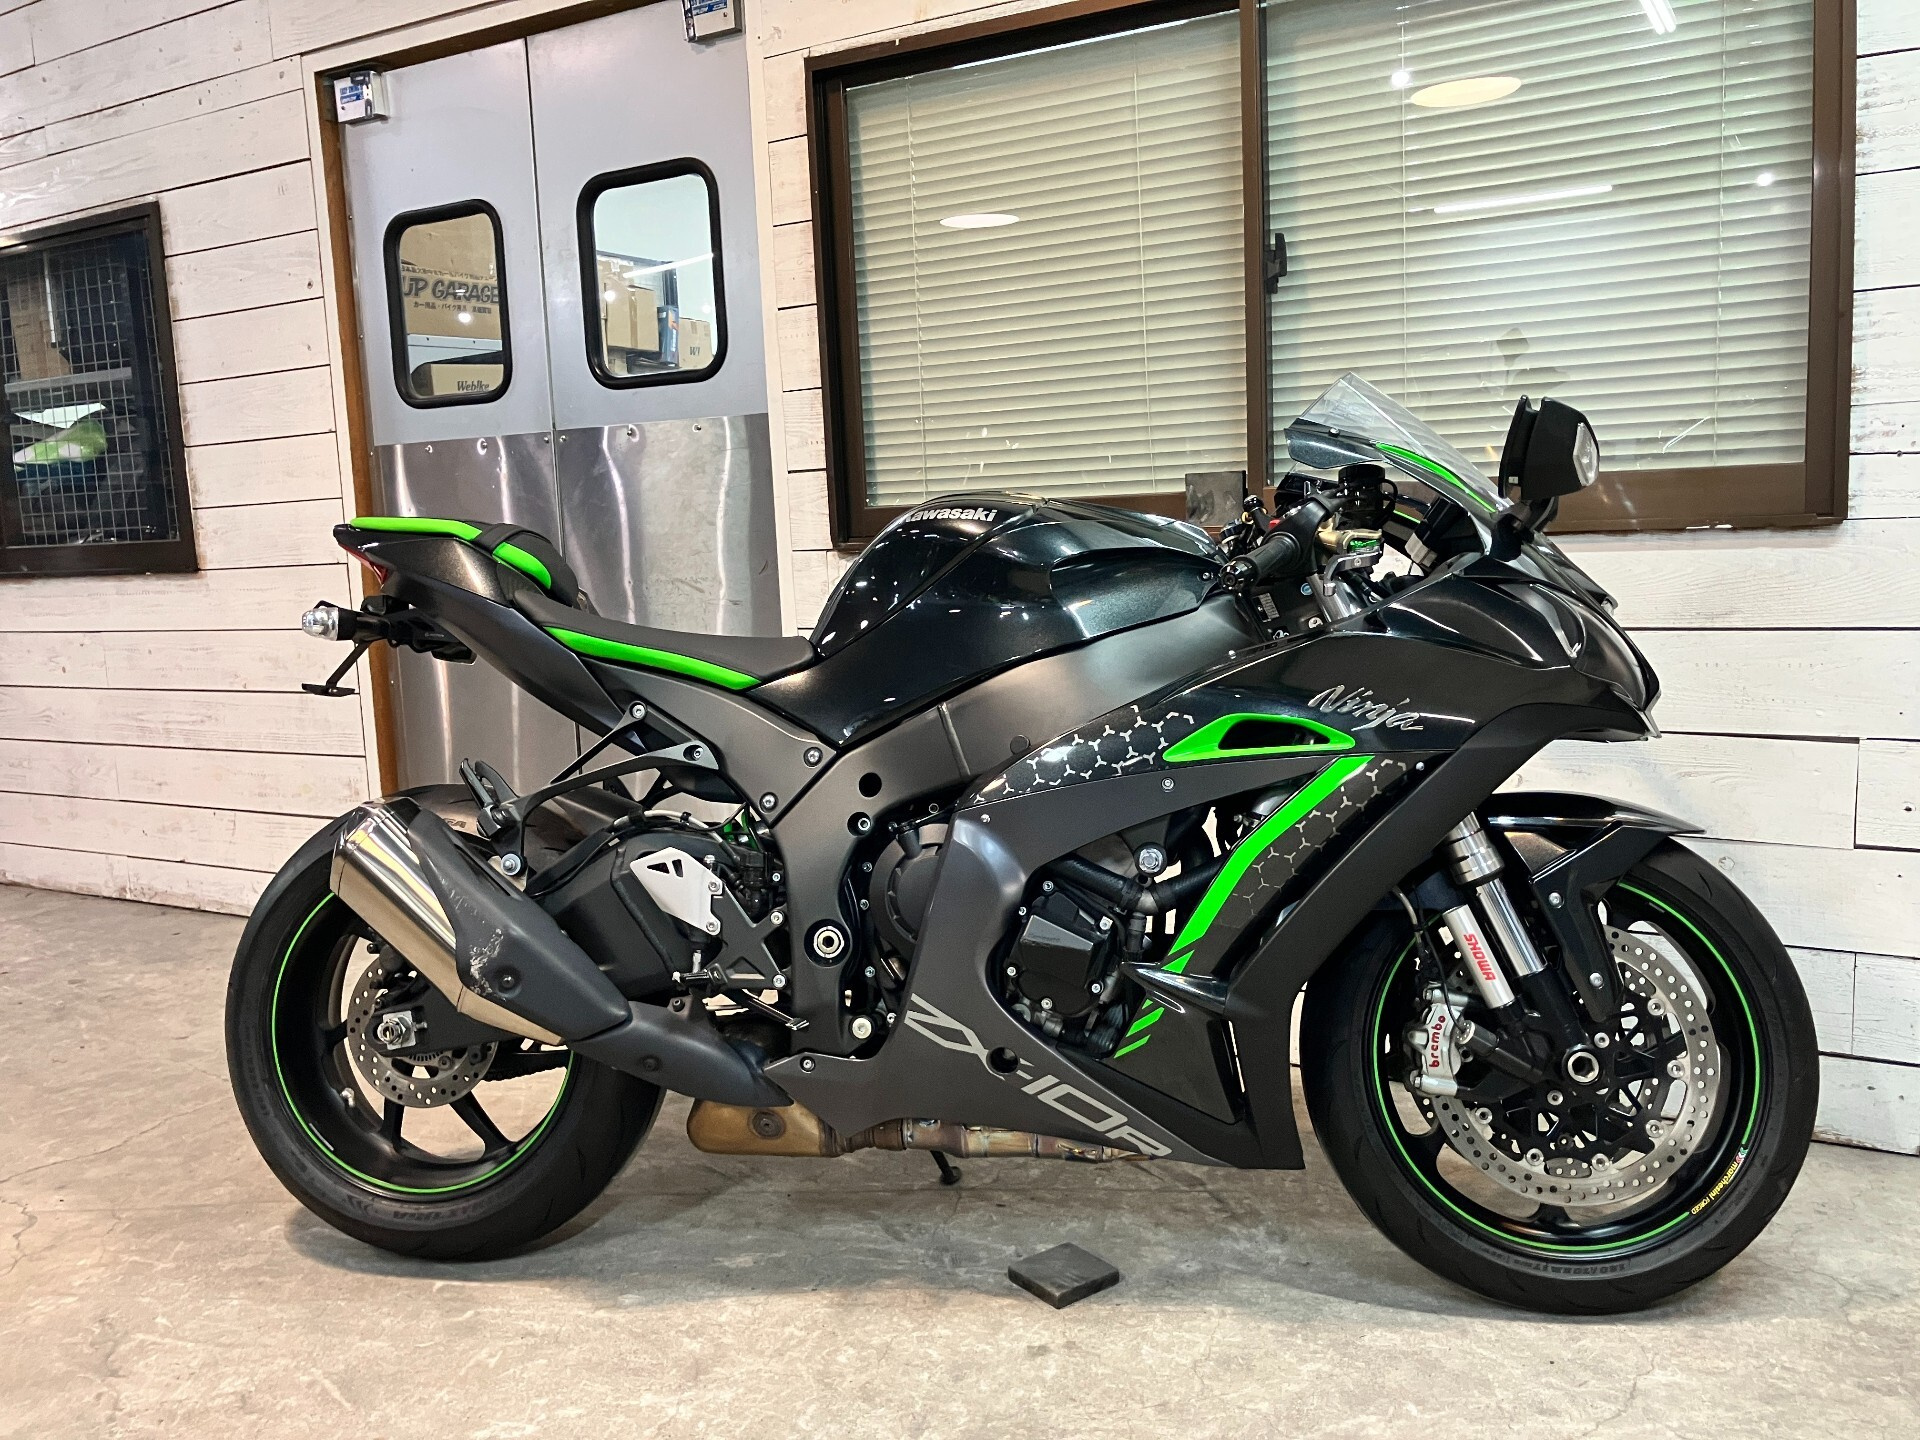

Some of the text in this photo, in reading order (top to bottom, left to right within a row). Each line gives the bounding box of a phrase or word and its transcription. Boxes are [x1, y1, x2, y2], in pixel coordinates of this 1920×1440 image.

[402, 275, 499, 304] UP GARAGE
[1307, 684, 1424, 732] Ninja
[1463, 933, 1496, 981] SHOWA
[1428, 1015, 1447, 1068] brembo
[904, 993, 1173, 1158] ZX-10R
[1691, 1161, 1739, 1215] marchesini FORGED
